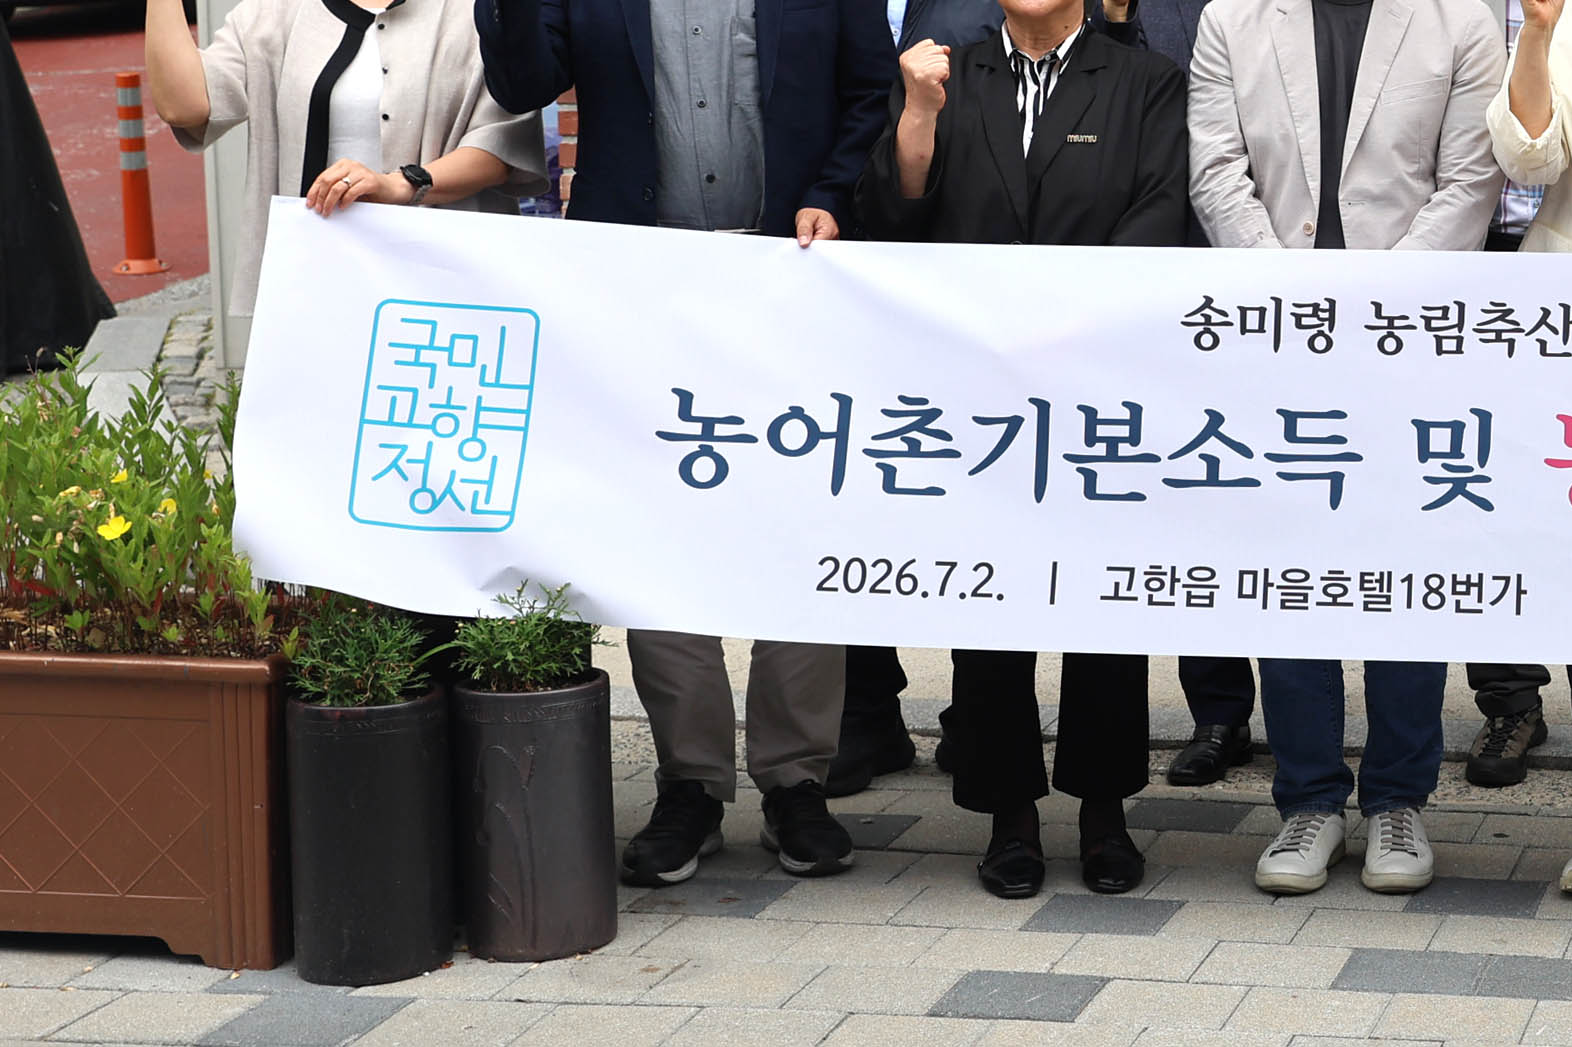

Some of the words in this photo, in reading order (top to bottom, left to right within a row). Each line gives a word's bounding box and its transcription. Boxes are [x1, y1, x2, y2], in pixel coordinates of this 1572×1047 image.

[387, 317, 532, 390] 국민
[1180, 295, 1337, 355] 송미령
[361, 385, 528, 463] 고향
[655, 387, 1364, 511] 농어촌기본소득
[1410, 407, 1495, 513] 및
[371, 441, 513, 516] 정선
[815, 556, 1004, 601] 2026.7.2.
[1099, 564, 1220, 608] 고한읍
[1237, 567, 1528, 616] 마을호텔18번가
